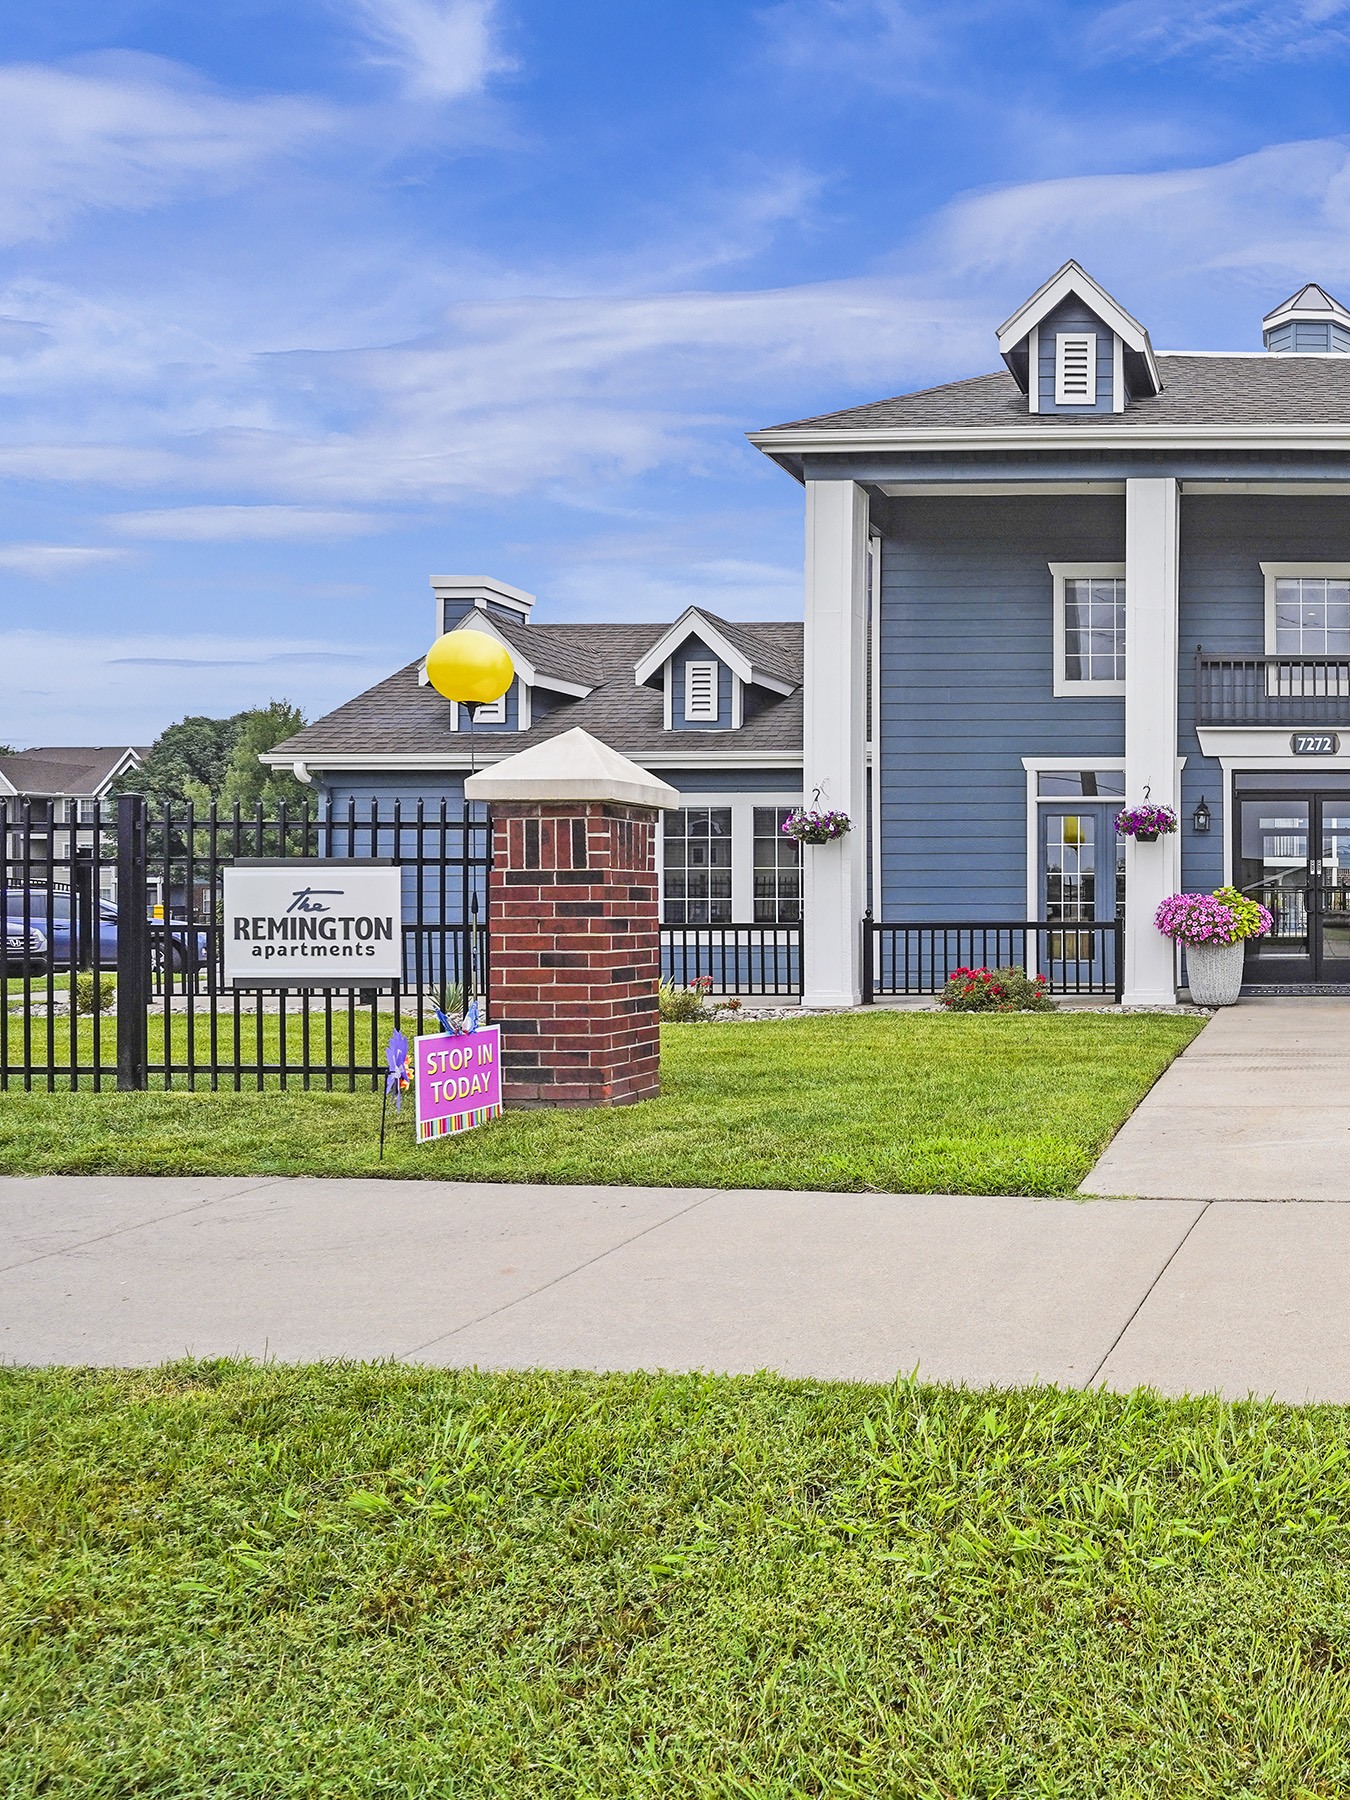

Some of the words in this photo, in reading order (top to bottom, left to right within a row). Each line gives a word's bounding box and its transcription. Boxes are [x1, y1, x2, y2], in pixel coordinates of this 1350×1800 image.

[1297, 737, 1331, 751] 7272
[286, 886, 345, 914] The
[233, 916, 393, 941] REMINGTON
[252, 942, 376, 959] apartments
[426, 1046, 473, 1075] STOP
[477, 1043, 493, 1066] IN
[430, 1071, 491, 1104] TODAY
